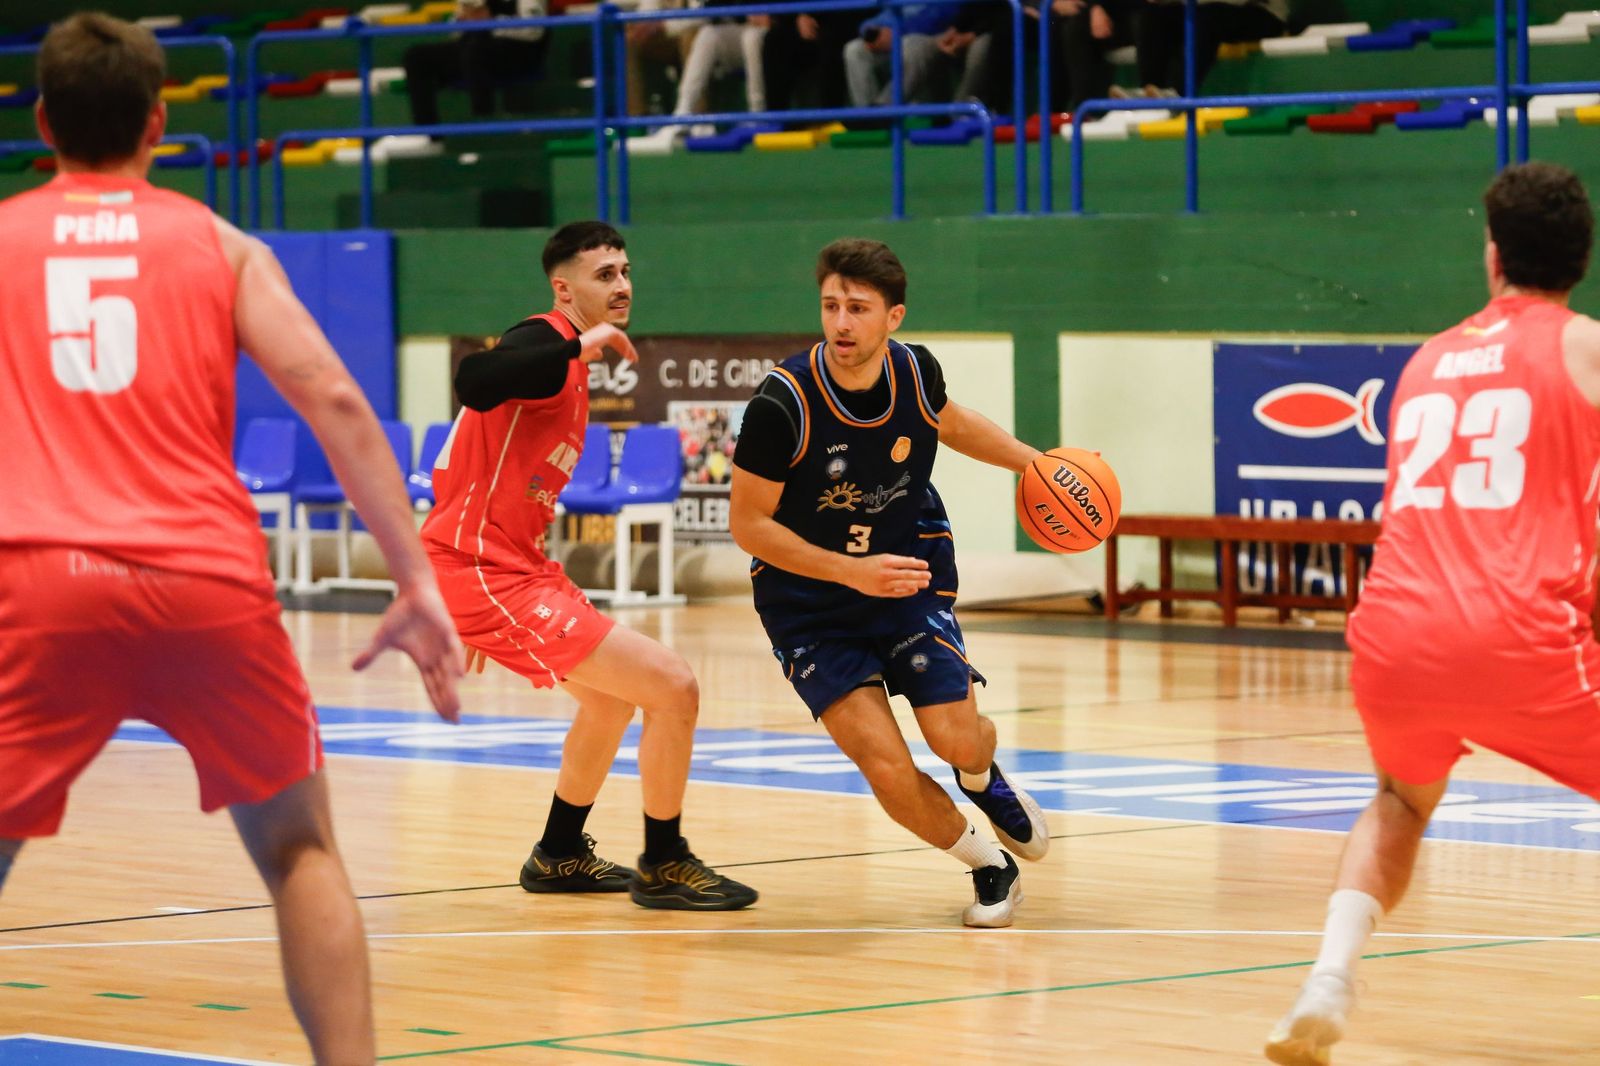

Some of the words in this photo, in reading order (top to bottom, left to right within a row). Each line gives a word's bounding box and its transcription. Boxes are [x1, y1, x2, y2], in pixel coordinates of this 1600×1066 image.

[54, 211, 140, 244] PEÑA
[45, 257, 139, 394] 5
[659, 358, 683, 388] C.
[688, 358, 718, 388] DE
[1432, 344, 1505, 379] ANGEL
[826, 443, 849, 455] vive
[1390, 388, 1532, 514] 23
[1052, 463, 1104, 529] Wilson
[846, 524, 873, 553] 3
[800, 663, 816, 680] vive
